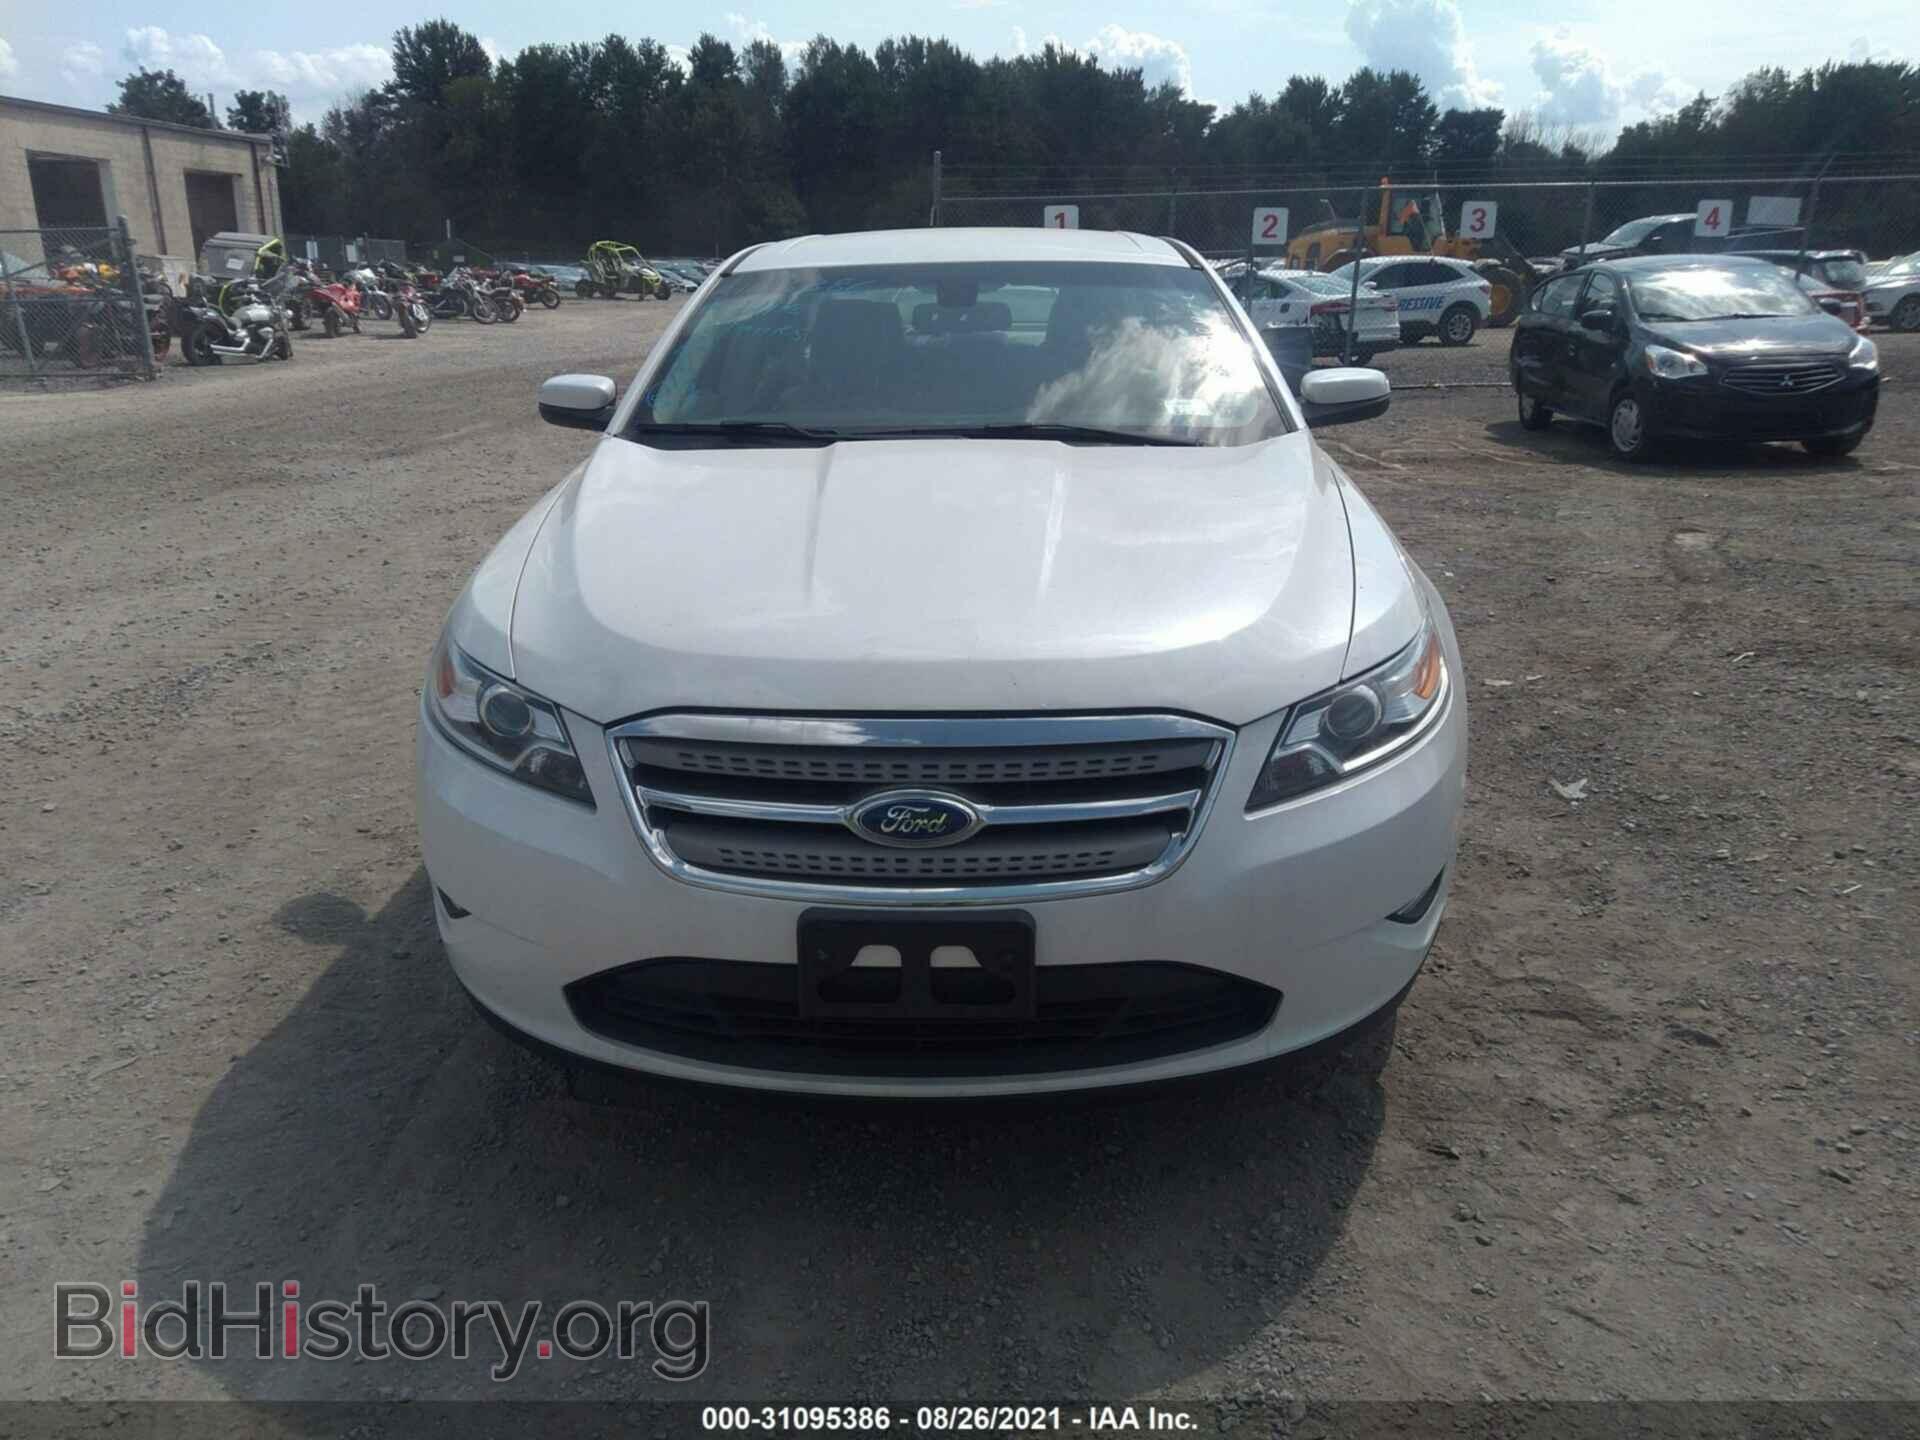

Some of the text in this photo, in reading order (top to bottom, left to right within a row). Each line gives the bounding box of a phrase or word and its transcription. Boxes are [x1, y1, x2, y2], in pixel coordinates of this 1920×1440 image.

[1055, 212, 1066, 229] 1
[1261, 213, 1279, 239] 2
[1470, 207, 1487, 233] 3
[1704, 206, 1721, 231] 4
[880, 804, 948, 833] Ford
